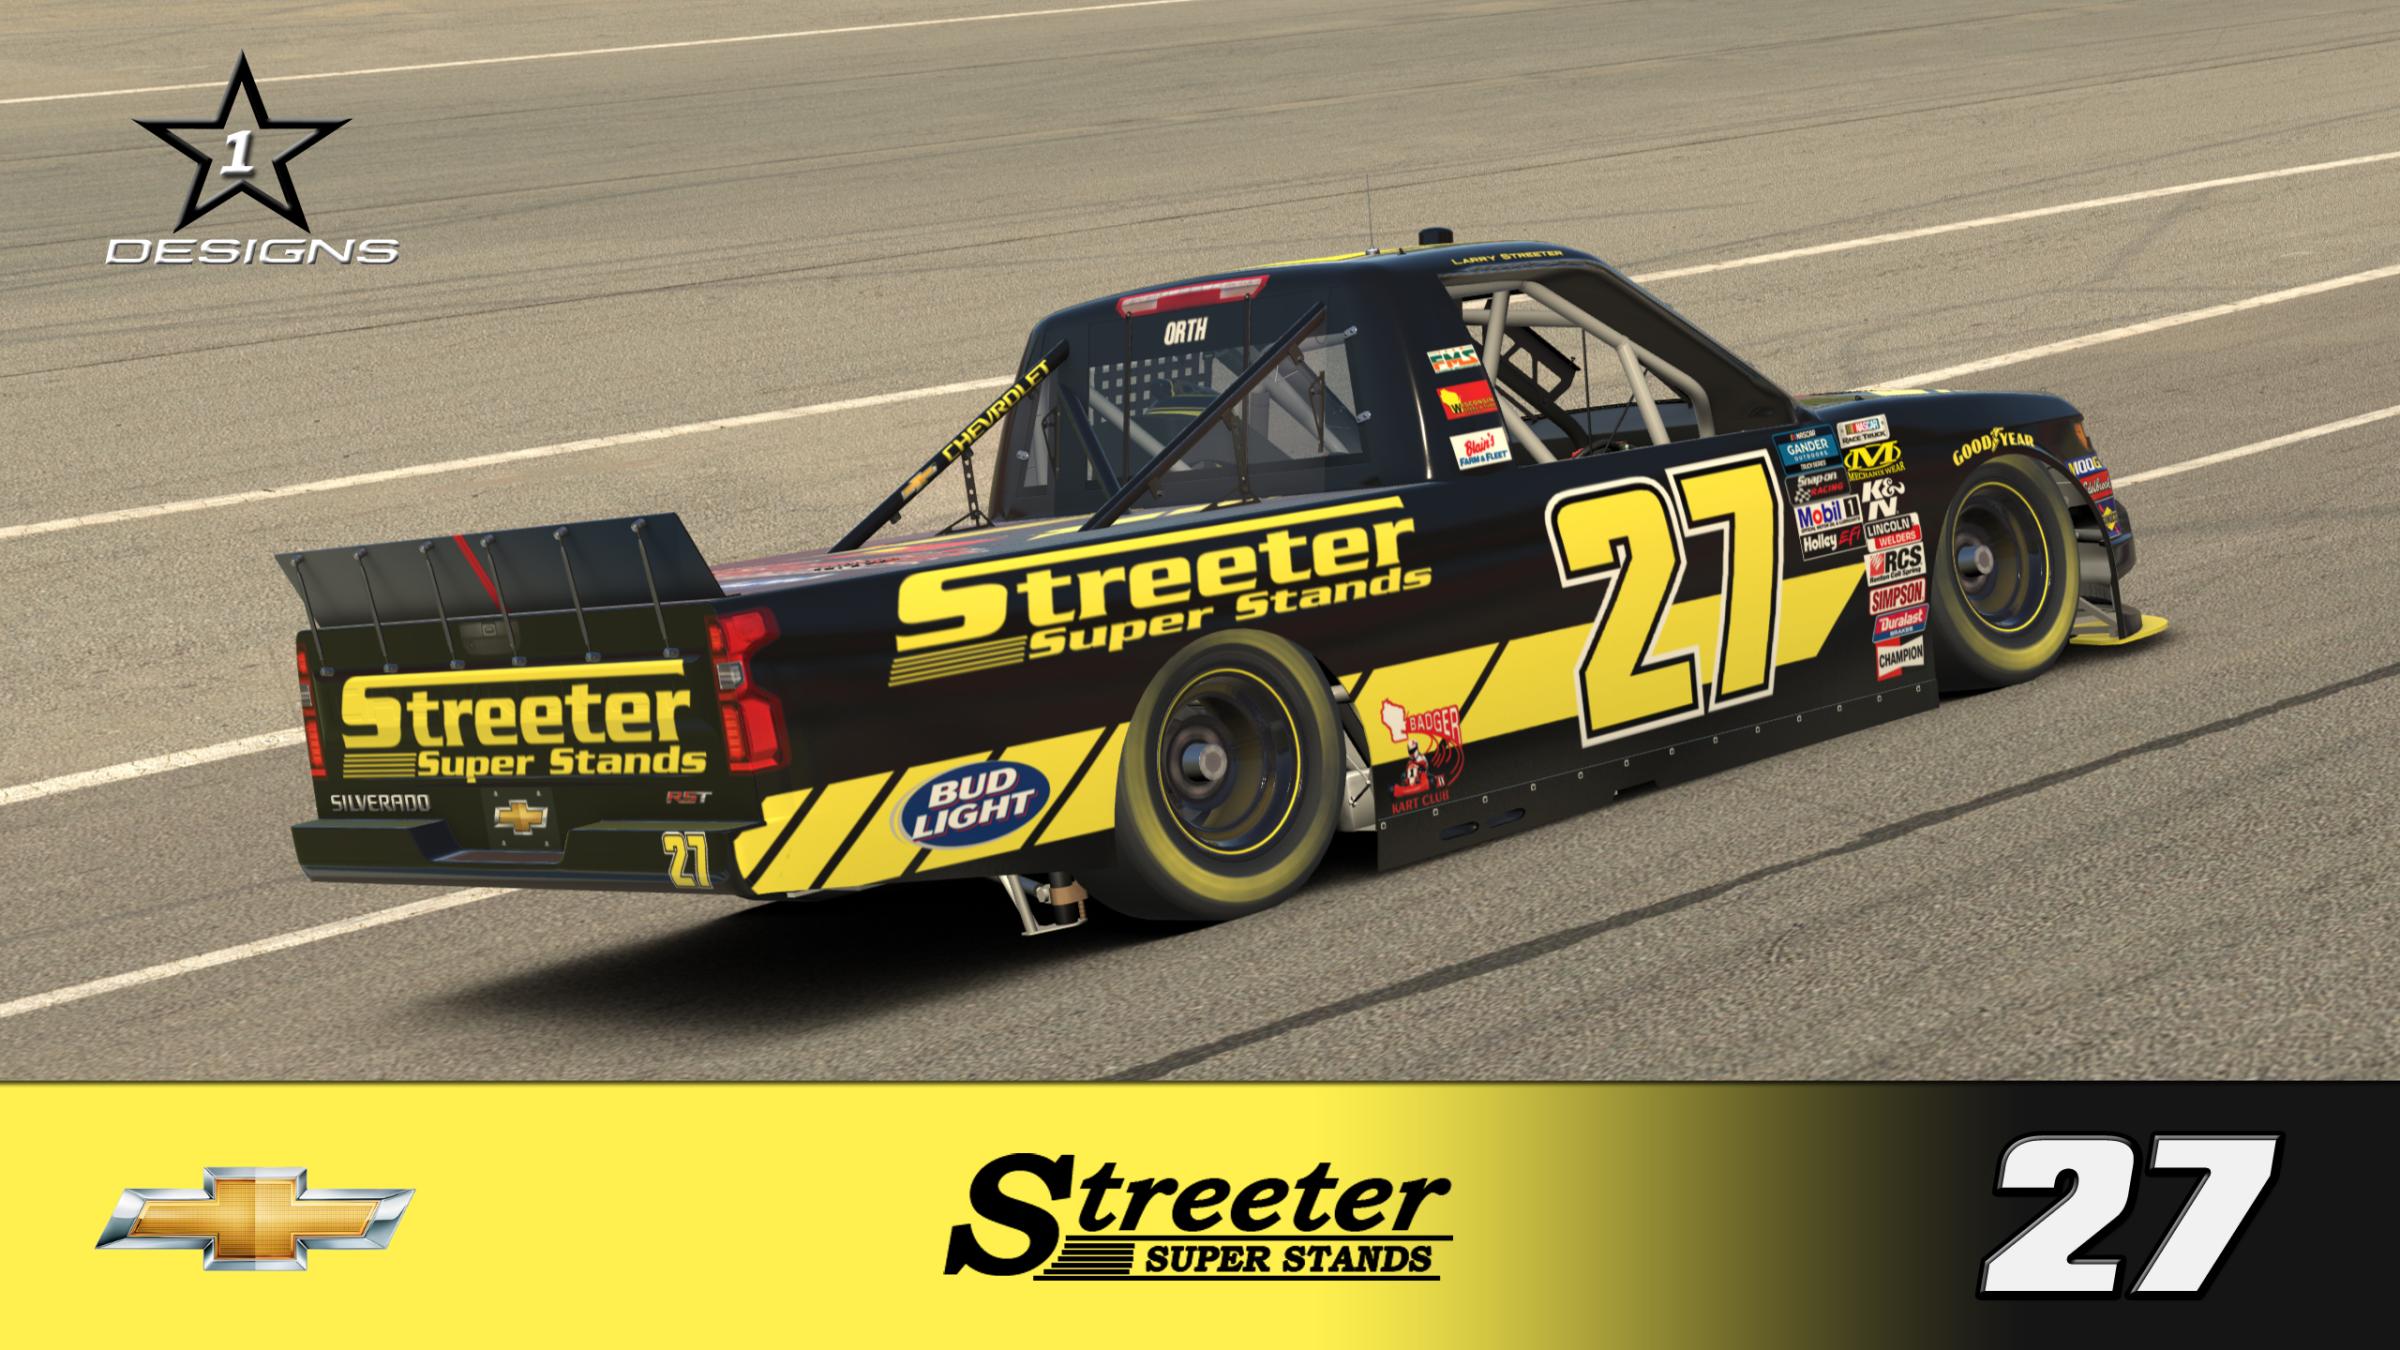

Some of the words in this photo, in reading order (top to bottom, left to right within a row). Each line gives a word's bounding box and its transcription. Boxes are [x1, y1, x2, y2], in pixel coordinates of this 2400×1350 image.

[1451, 255, 1497, 266] LARRY
[1500, 250, 1564, 260] STREETER
[1163, 316, 1209, 346] ORTH
[1429, 348, 1479, 372] FMS
[941, 358, 1051, 462] CHEVROLET
[1855, 418, 1879, 433] NASCAR
[1464, 432, 1495, 457] Blain's
[1786, 438, 1829, 456] GANDER
[1460, 455, 1480, 467] FARM
[1485, 450, 1508, 462] FLEET
[1885, 460, 1906, 475] WEAR
[1797, 471, 1838, 488] Snap-on
[1810, 482, 1844, 497] RACING
[1797, 499, 1842, 529] Mobil
[1847, 498, 1856, 516] 1
[1866, 517, 1911, 538] LINCOLN
[1878, 530, 1917, 547] WELDERS
[1803, 532, 1838, 553] Holley
[1884, 545, 1922, 574] RCS
[896, 496, 1415, 652] Streeter
[1544, 448, 1785, 749] 27
[1871, 580, 1923, 613] SIMPSON
[1028, 605, 1214, 661] Super
[1235, 566, 1433, 622] Stands
[1878, 608, 1924, 632] Duralast
[1879, 645, 1924, 668] CHAMPION
[341, 659, 691, 749] Streeter
[1408, 705, 1461, 744] BADGER
[417, 750, 535, 784] Super
[549, 745, 708, 777] Stands
[666, 790, 713, 805] RST
[928, 767, 1019, 809] BUD
[330, 794, 432, 813] SILVERADO
[911, 788, 1038, 842] LIGHT
[1391, 797, 1419, 815] KART
[1422, 790, 1450, 806] CLUB
[661, 831, 714, 890] 27
